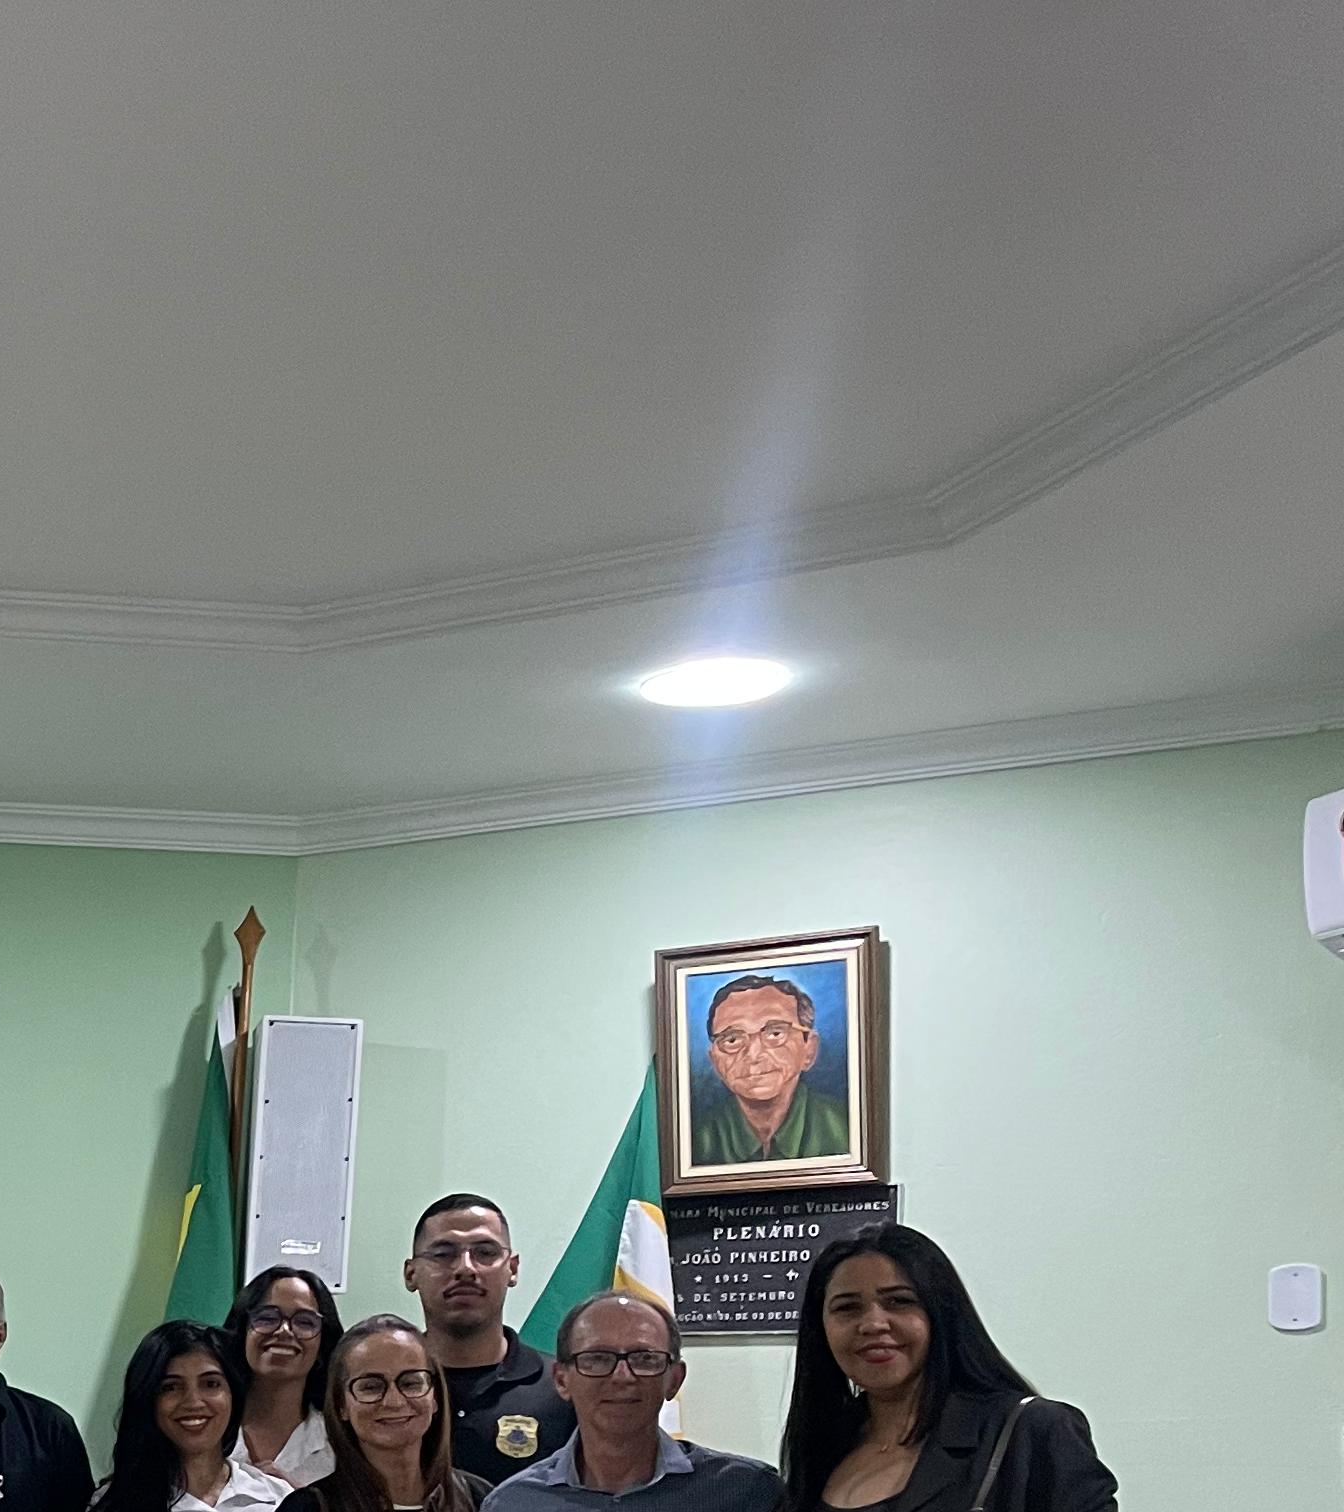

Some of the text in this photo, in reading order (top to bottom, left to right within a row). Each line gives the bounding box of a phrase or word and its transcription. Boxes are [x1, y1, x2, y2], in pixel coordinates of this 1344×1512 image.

[783, 1204, 800, 1214] DE
[806, 1201, 890, 1213] VEREADORES
[713, 1219, 820, 1240] PLENÁRIO
[730, 1249, 811, 1264] PINHEIRO
[693, 1293, 711, 1302] DE
